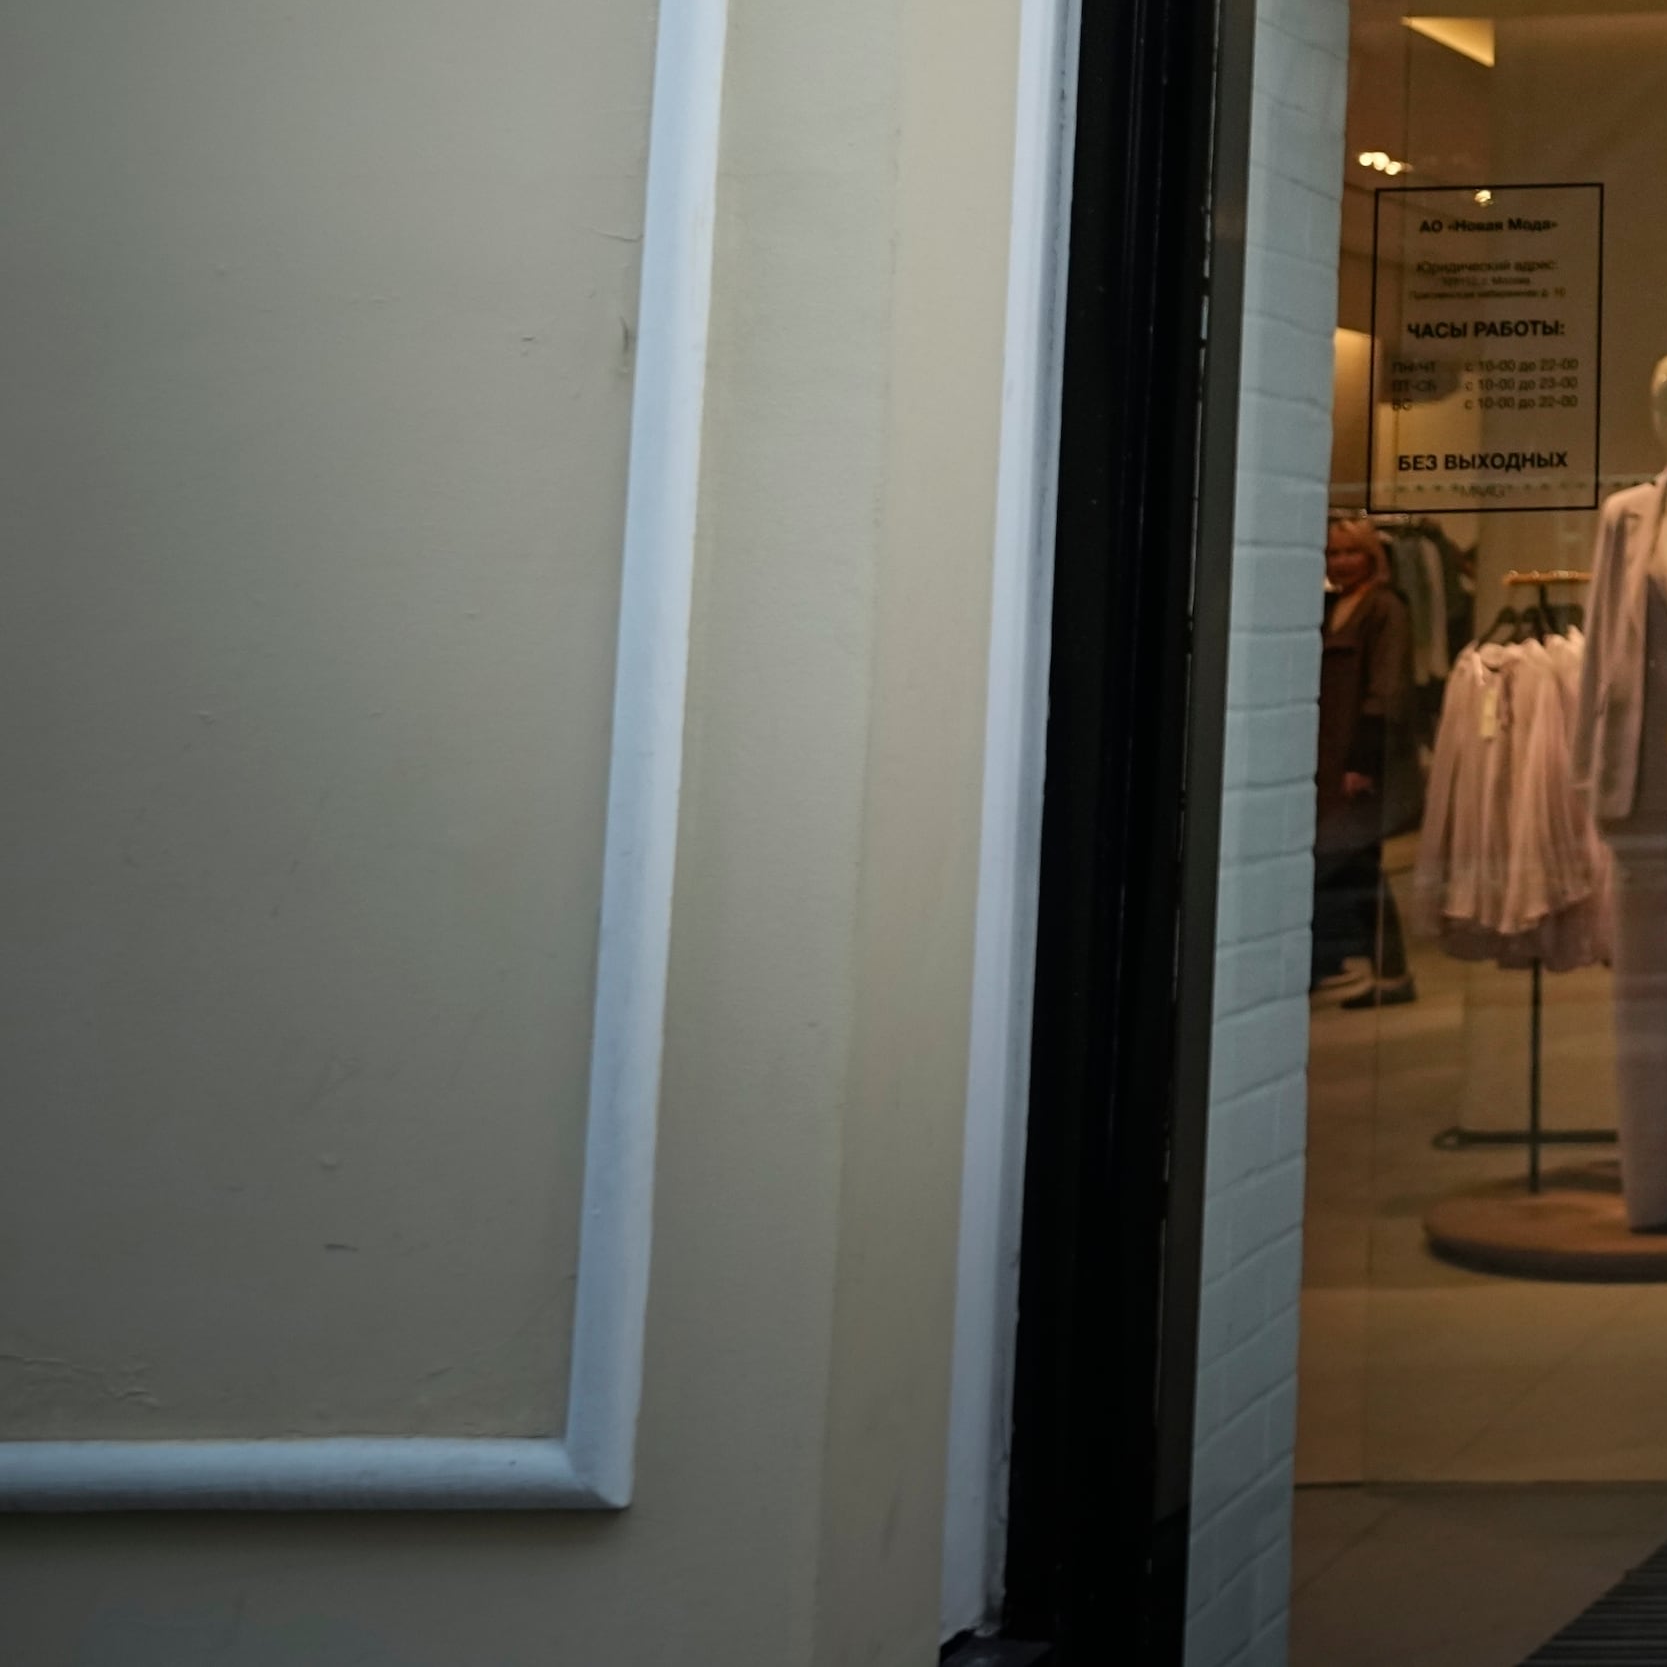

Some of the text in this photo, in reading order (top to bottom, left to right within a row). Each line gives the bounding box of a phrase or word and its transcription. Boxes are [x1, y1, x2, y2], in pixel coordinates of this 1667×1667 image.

[1419, 220, 1443, 233] АО
[1407, 319, 1566, 340] ЧАСЫ РАБОТЫ:
[1478, 359, 1516, 373] 10-00
[1518, 361, 1537, 374] до
[1539, 358, 1579, 372] 22-00
[1478, 378, 1516, 392] 10-00
[1518, 379, 1537, 393] до
[1478, 396, 1516, 410] 10-00
[1518, 398, 1537, 411] до
[1539, 395, 1578, 409] 22-00
[1398, 451, 1568, 473] БЕЗ ВЫХОДНЫХ
